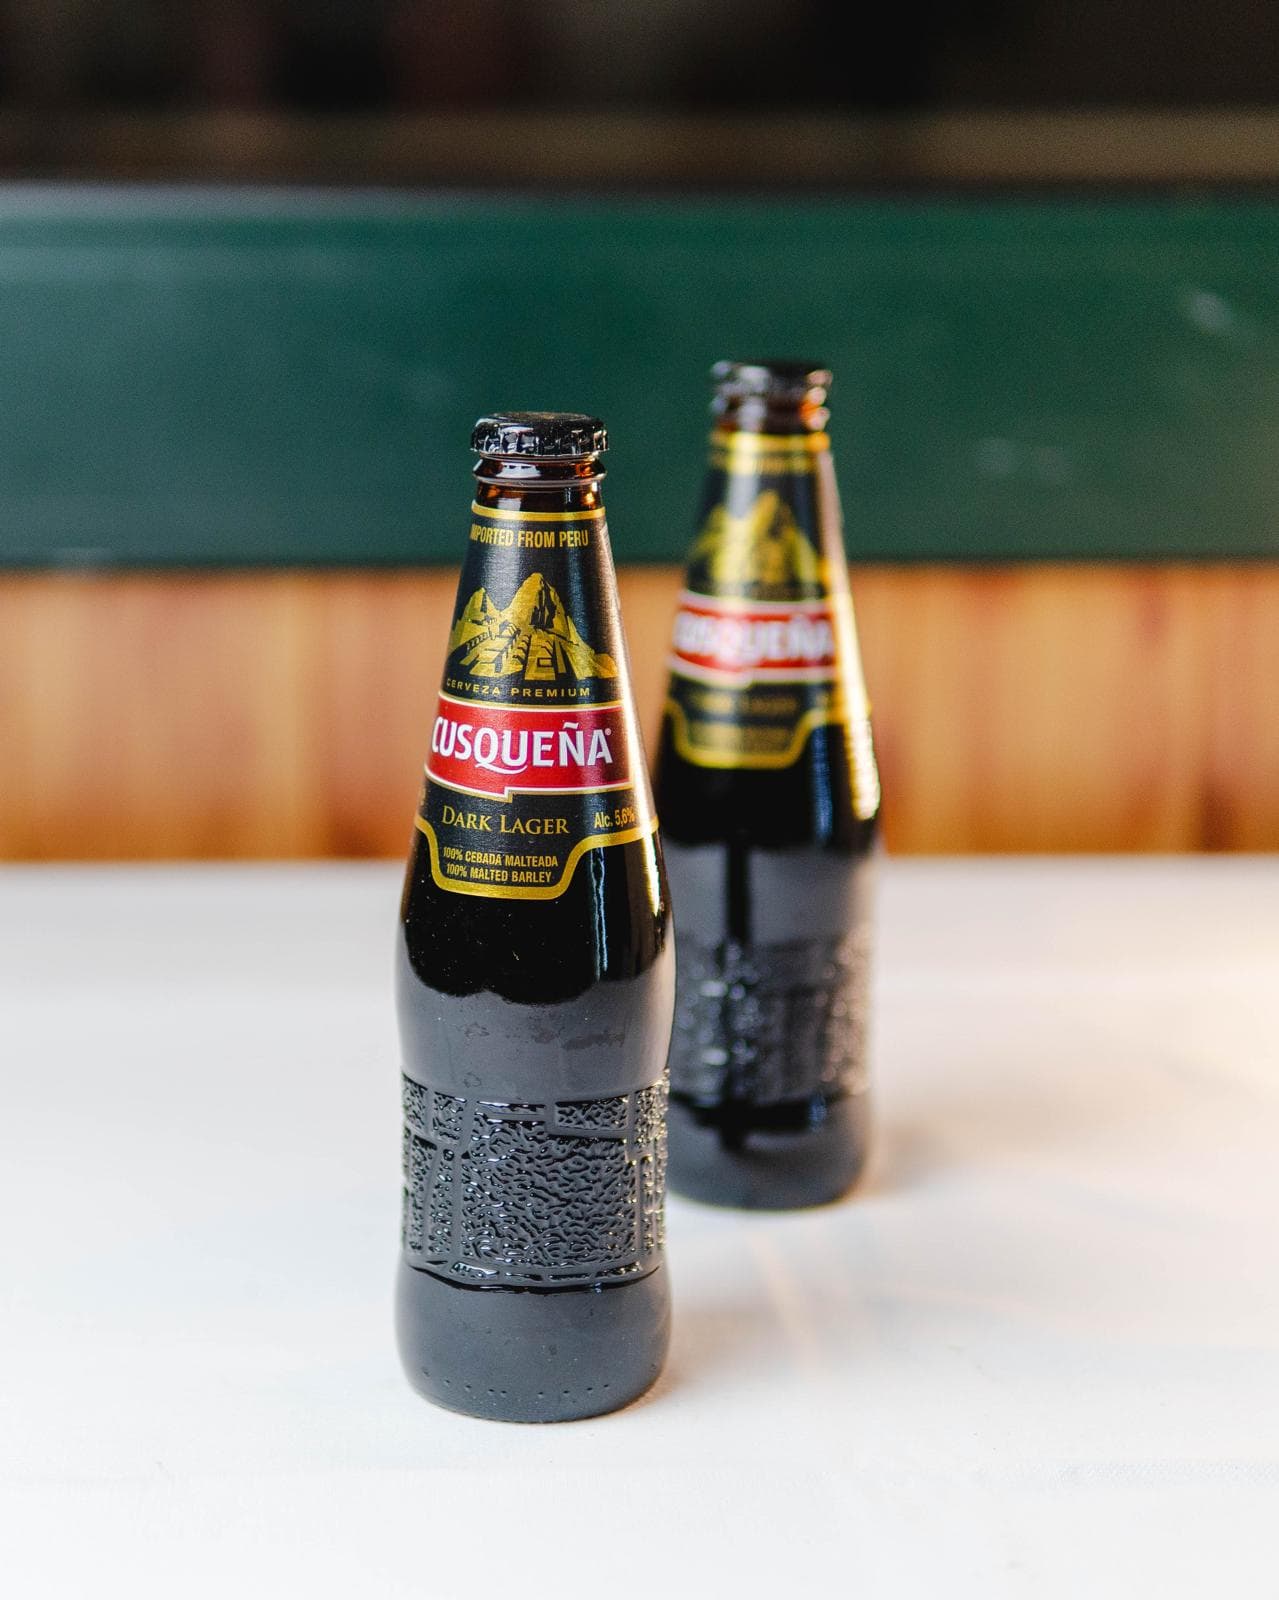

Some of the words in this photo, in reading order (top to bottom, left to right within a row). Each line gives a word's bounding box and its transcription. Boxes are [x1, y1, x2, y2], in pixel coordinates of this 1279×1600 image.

[517, 530, 555, 548] FROM
[559, 529, 589, 547] PERU
[447, 678, 500, 696] CERVEZA
[511, 687, 590, 697] PREMIUM
[431, 716, 613, 774] CUSQUEÑA
[594, 811, 613, 829] Alc.
[443, 846, 463, 861] 100%
[465, 850, 502, 866] CEBADA
[505, 855, 559, 867] MALTEADA
[446, 863, 468, 877] 100%
[470, 867, 508, 882] MALTED
[511, 871, 552, 883] BARLEY
